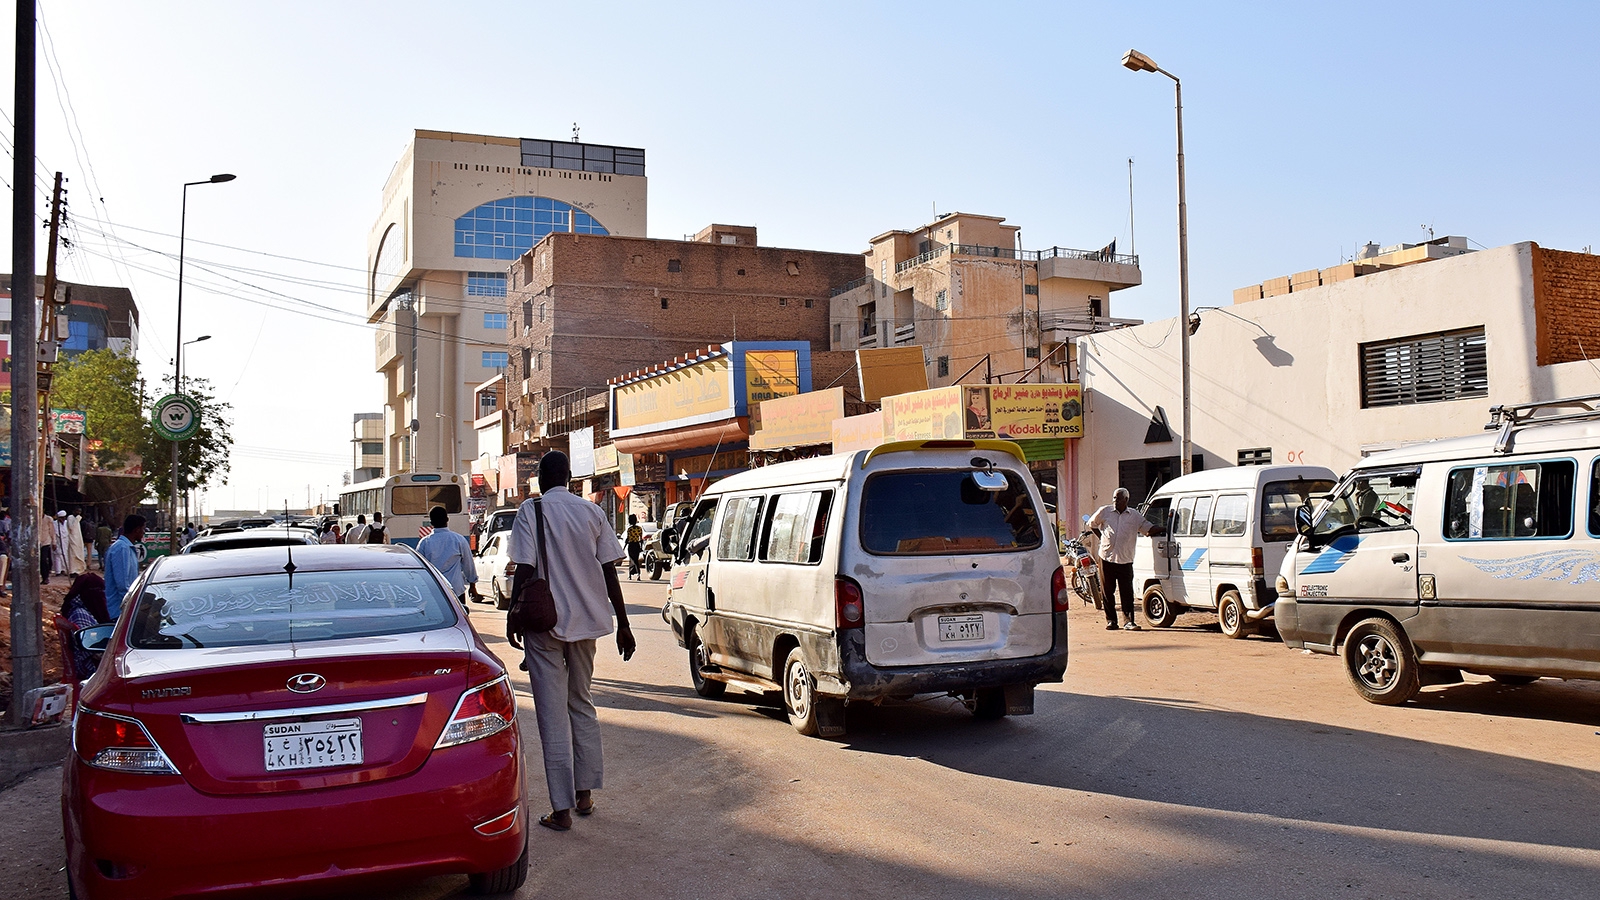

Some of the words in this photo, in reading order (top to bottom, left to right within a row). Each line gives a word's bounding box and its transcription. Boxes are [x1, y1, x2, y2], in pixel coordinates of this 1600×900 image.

[1009, 424, 1041, 434] Kodak
[1042, 424, 1080, 436] Express
[142, 686, 192, 698] HYUNDAI
[268, 725, 301, 734] SUDAN
[304, 733, 357, 755] ٣٥٤٣٢
